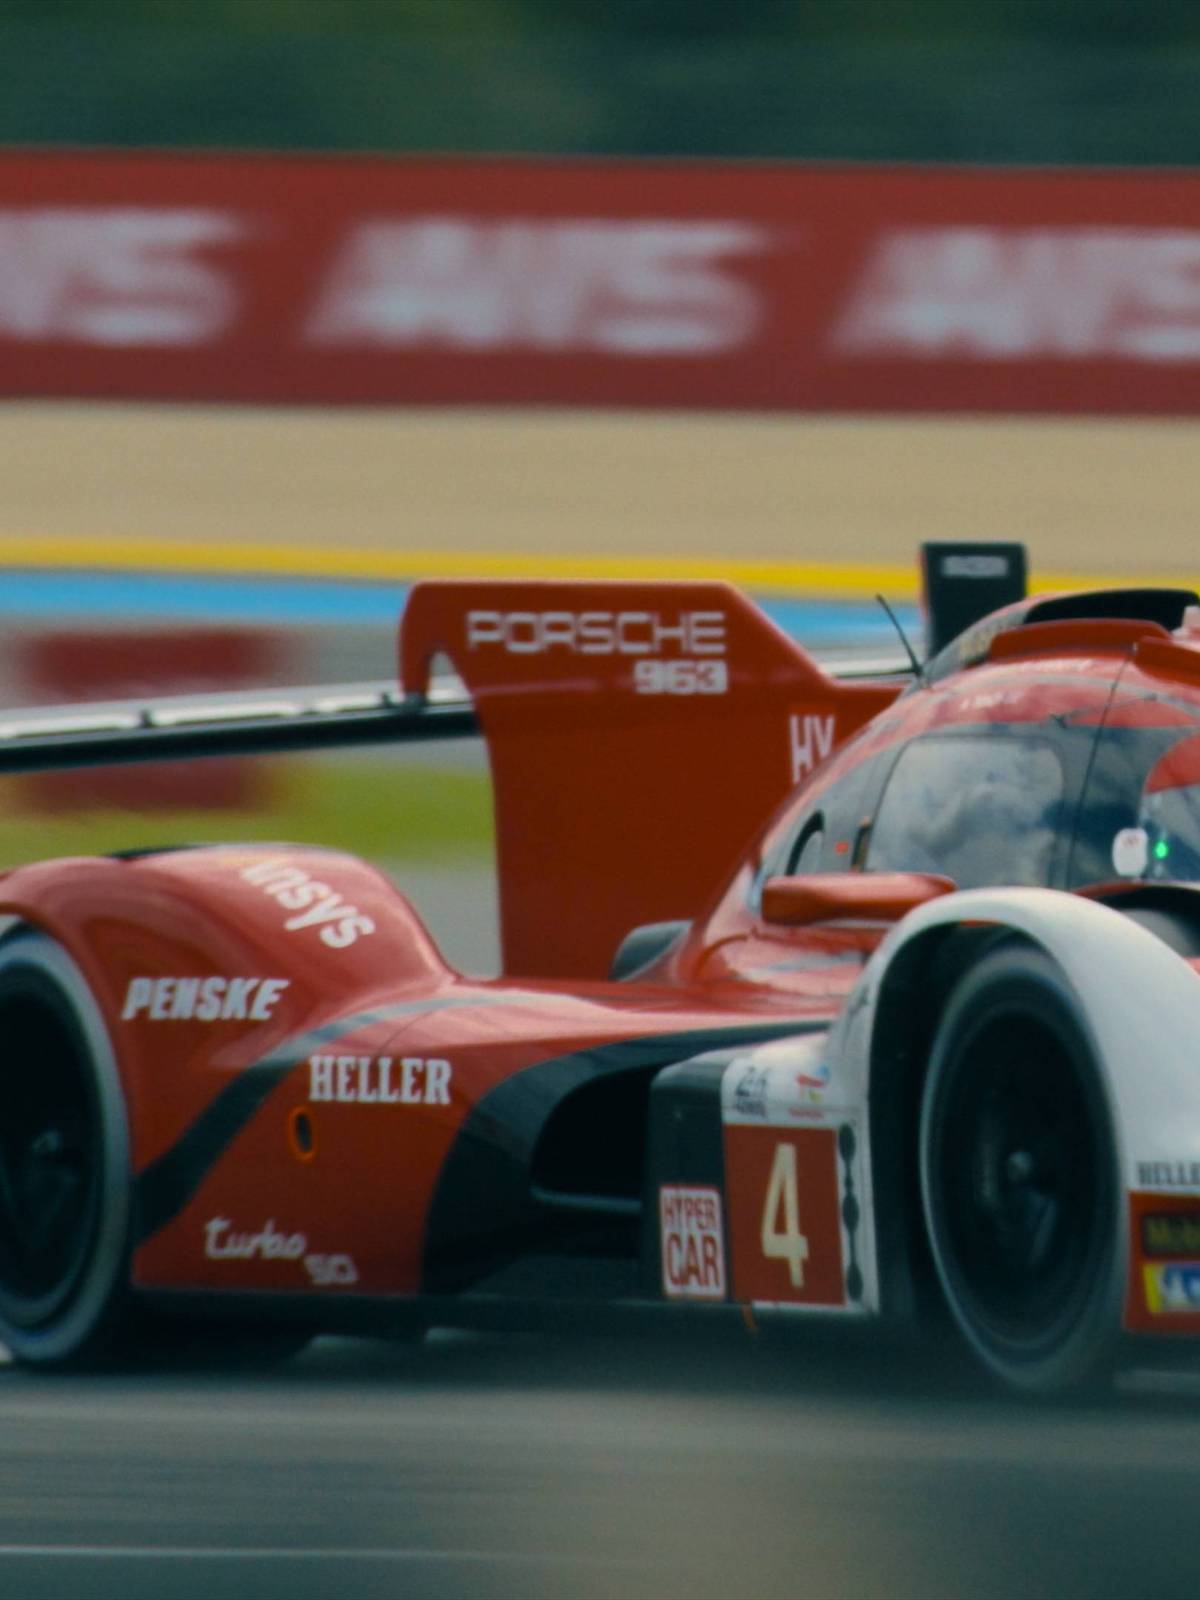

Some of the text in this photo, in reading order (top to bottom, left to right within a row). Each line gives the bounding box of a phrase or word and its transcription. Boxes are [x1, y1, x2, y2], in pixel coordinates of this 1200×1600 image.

[466, 610, 726, 653] PORSCHE
[634, 660, 729, 694] 963
[122, 976, 290, 1021] PENSKE
[309, 1055, 452, 1104] HELLER
[761, 1143, 809, 1288] 4
[667, 1233, 721, 1288] CAR
